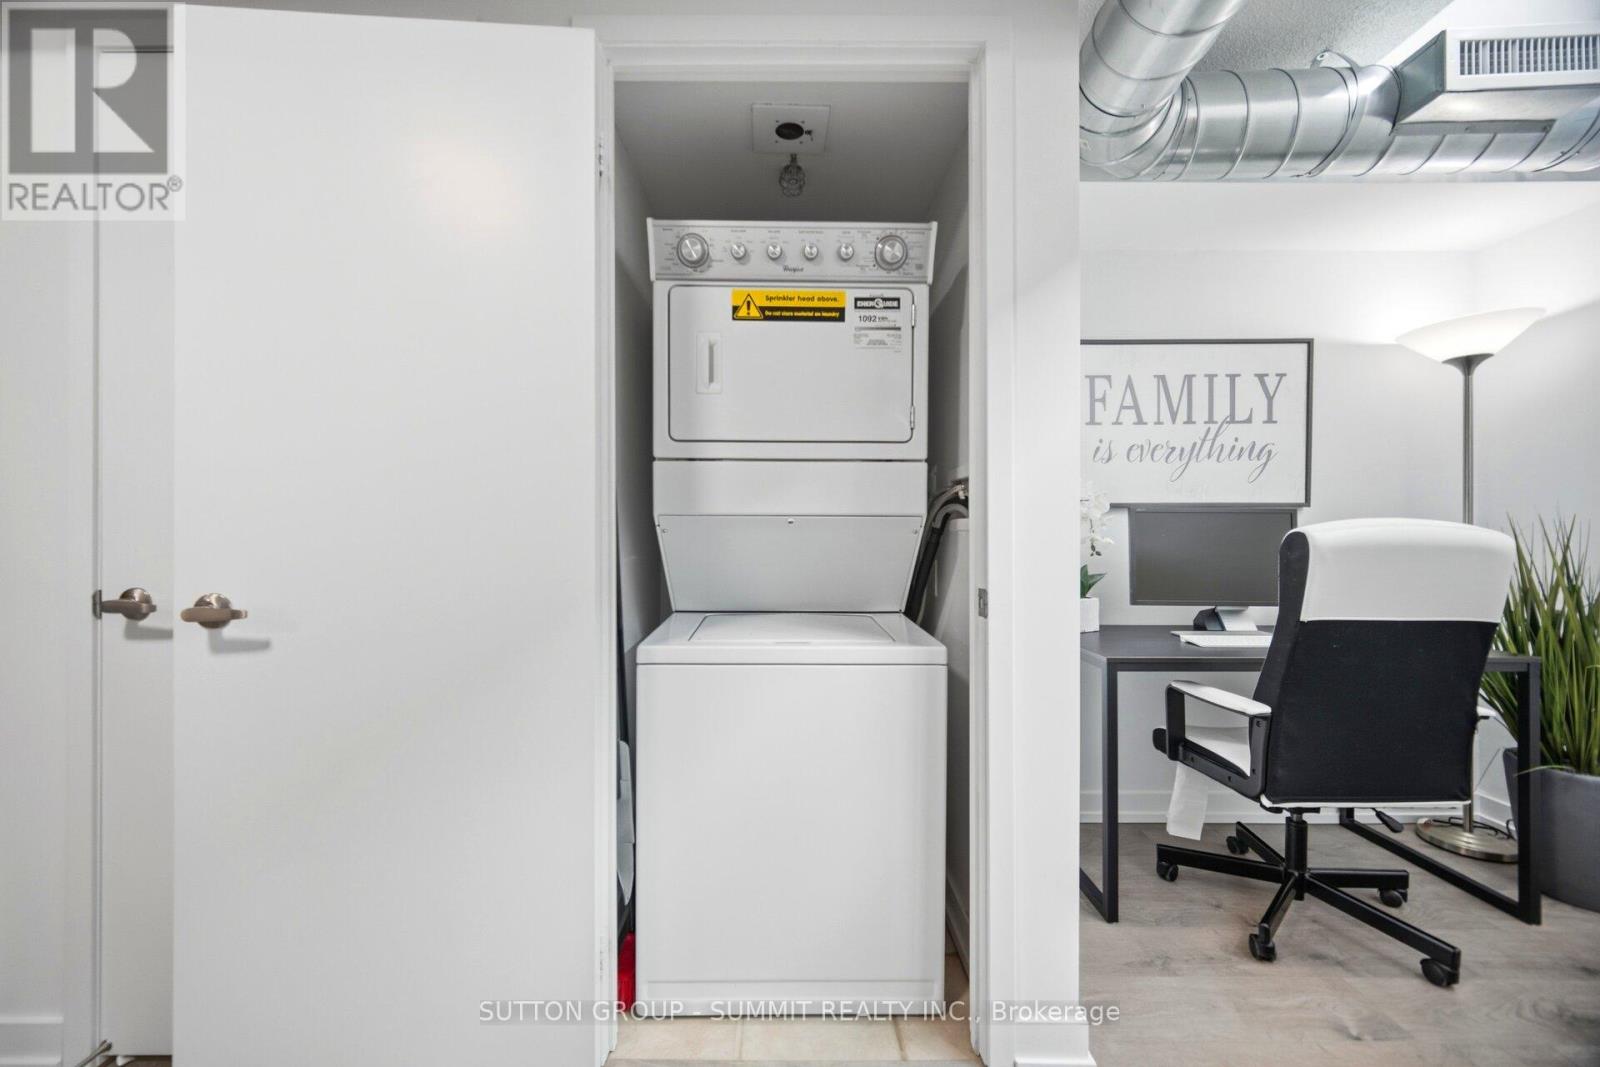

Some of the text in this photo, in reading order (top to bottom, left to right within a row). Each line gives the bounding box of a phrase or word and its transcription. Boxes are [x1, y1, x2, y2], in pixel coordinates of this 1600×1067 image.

[765, 295, 795, 303] Sprinkler
[1084, 373, 1288, 425] FAMILY
[1092, 415, 1278, 484] is everything
